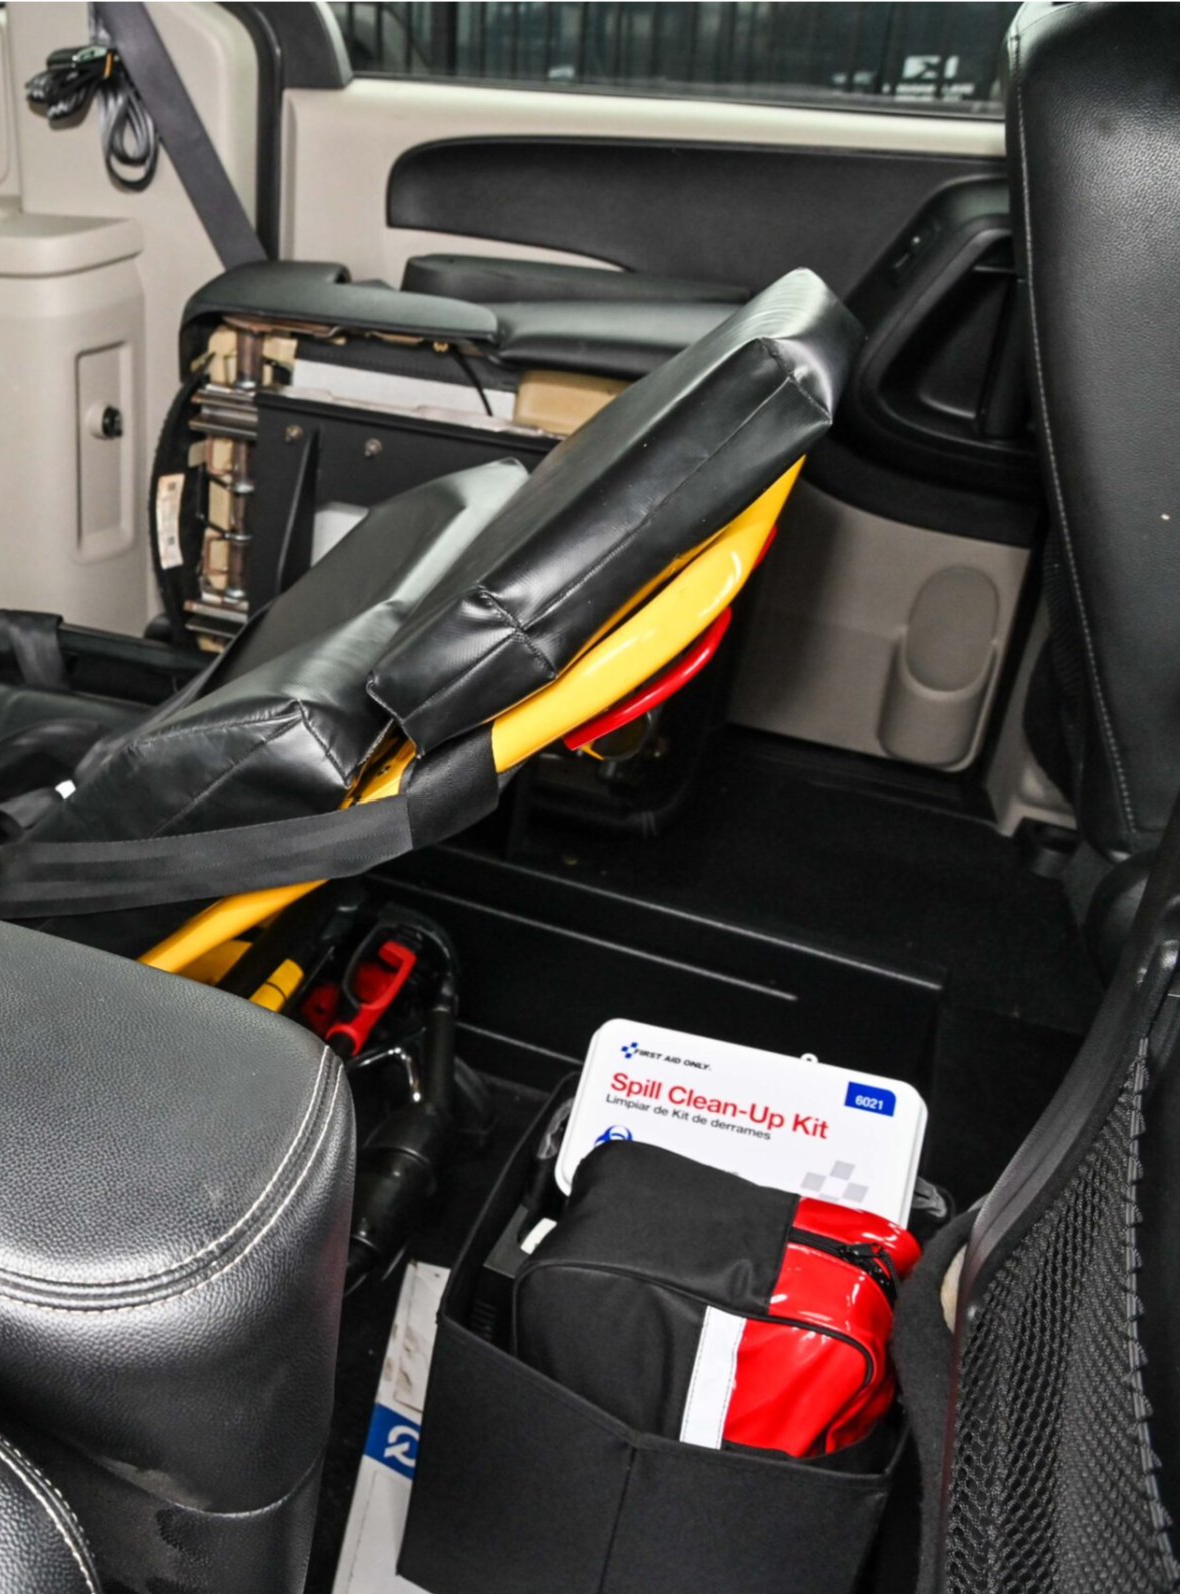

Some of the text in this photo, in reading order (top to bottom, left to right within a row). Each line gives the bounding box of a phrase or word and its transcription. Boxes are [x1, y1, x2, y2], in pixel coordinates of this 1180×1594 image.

[634, 1048, 663, 1060] FIRST
[664, 1055, 682, 1064] AID
[606, 1093, 771, 1140] Limpiar de Kit de derrames
[611, 1072, 829, 1139] Spill Clean-Up Kit
[855, 1094, 884, 1111] 6021
